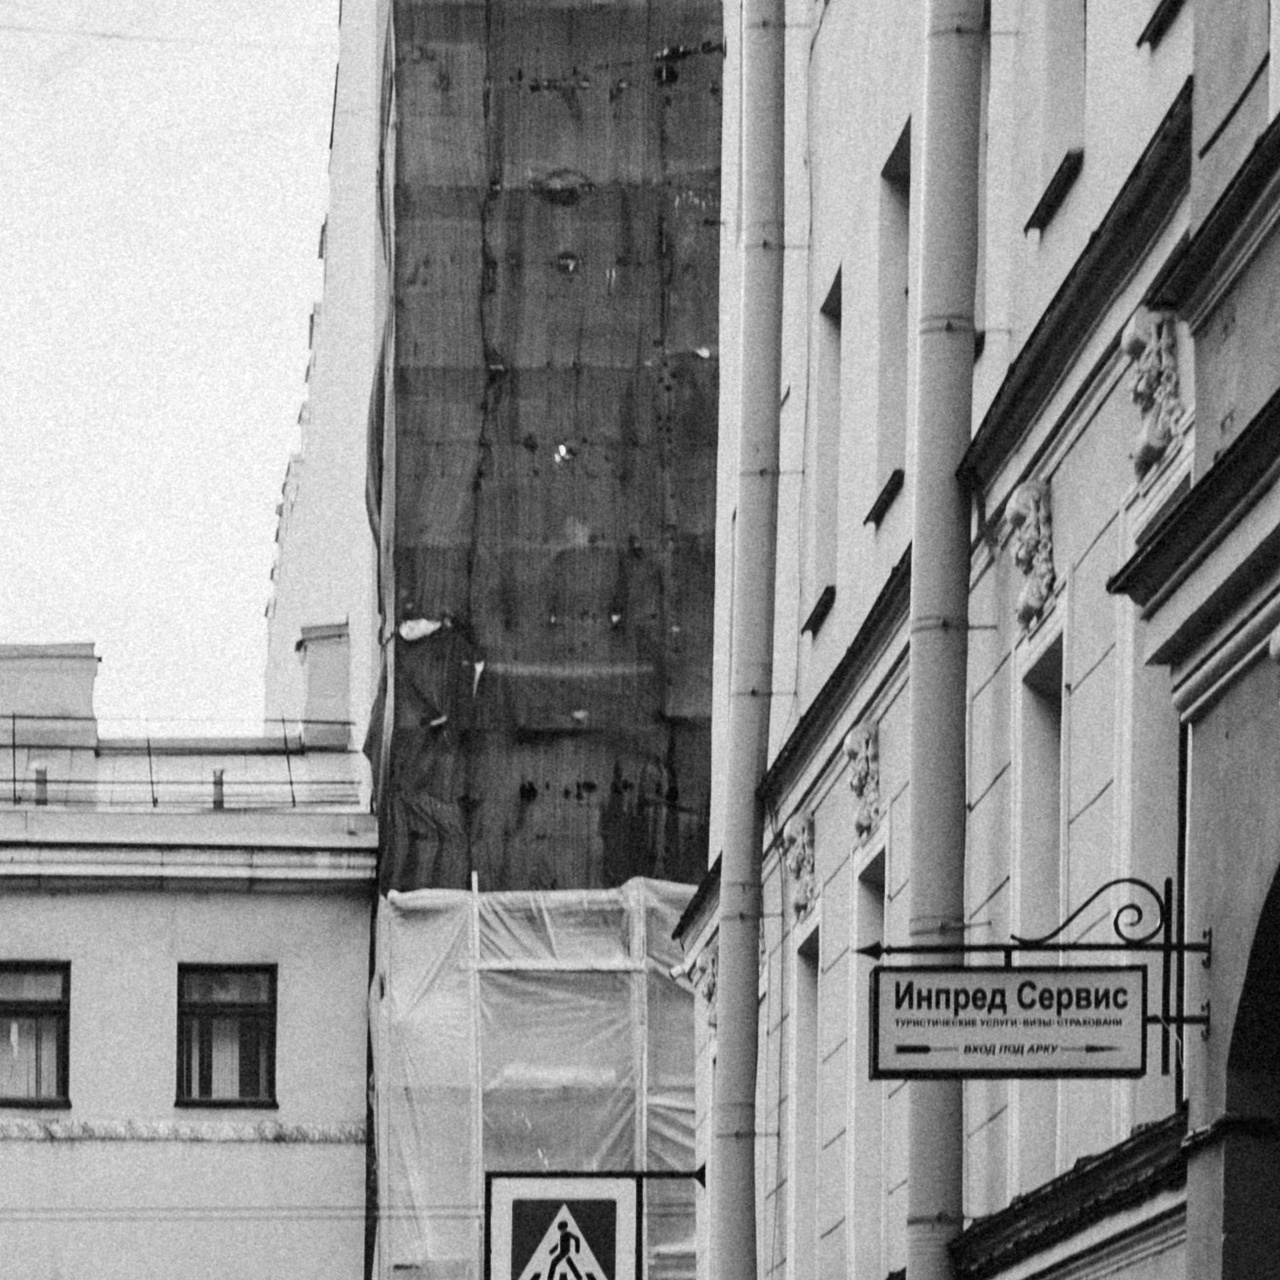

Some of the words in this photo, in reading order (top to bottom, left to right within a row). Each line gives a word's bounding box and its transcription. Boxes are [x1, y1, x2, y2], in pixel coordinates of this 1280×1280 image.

[894, 980, 1008, 1017] Инпред
[1016, 980, 1129, 1017] Сервис
[963, 1044, 996, 1056] ВХОД
[998, 1044, 1024, 1056] ПОД
[1026, 1044, 1059, 1055] АРКУ
